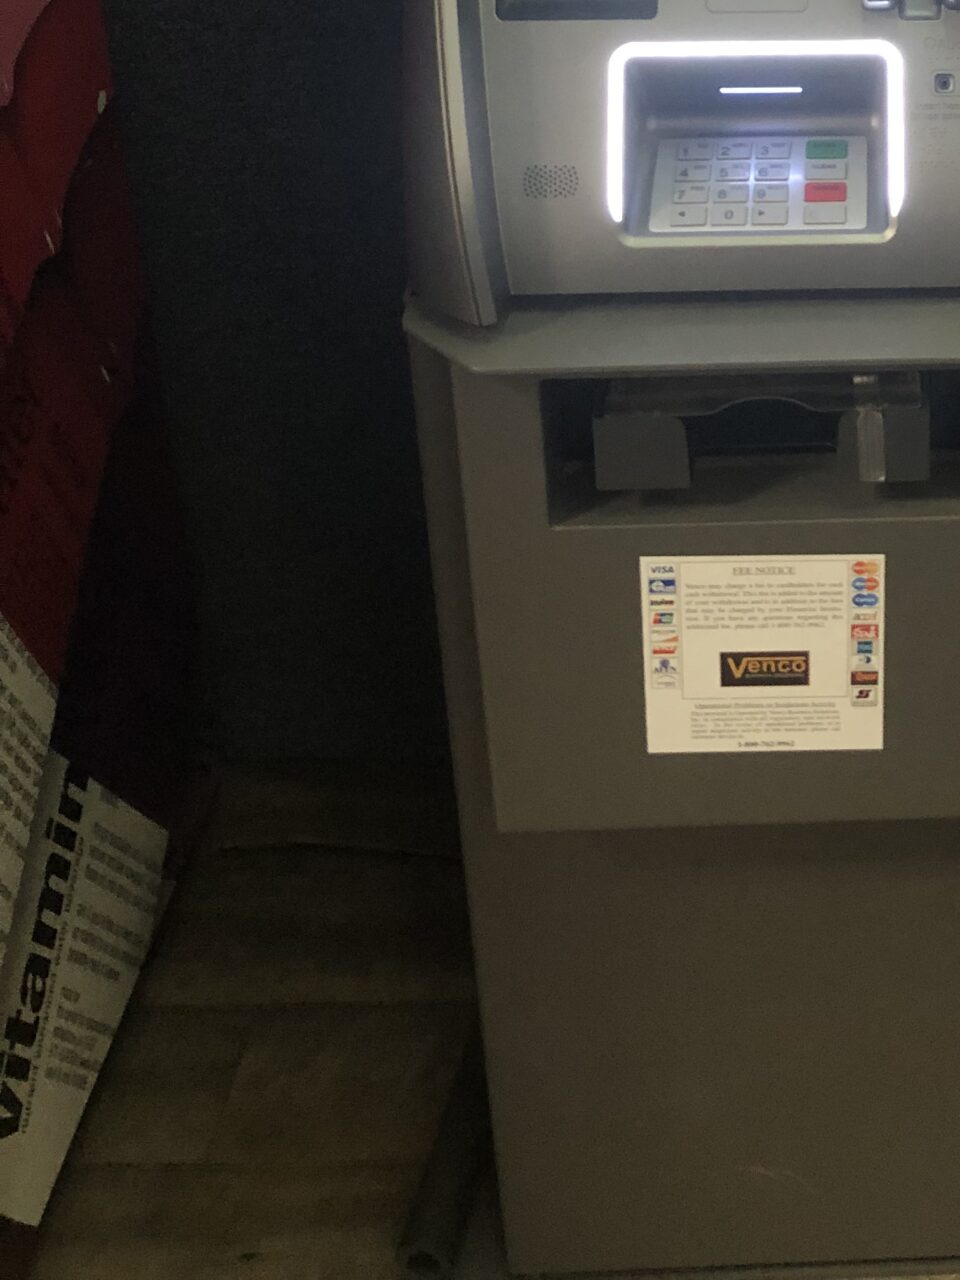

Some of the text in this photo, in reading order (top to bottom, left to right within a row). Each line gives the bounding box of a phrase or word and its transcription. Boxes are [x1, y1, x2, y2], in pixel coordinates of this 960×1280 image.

[720, 146, 730, 156] 2
[760, 145, 769, 155] 3
[679, 167, 689, 177] 4
[719, 167, 729, 177] 5
[677, 189, 686, 199] 7
[650, 566, 674, 574] VISA
[727, 656, 807, 679] Venco
